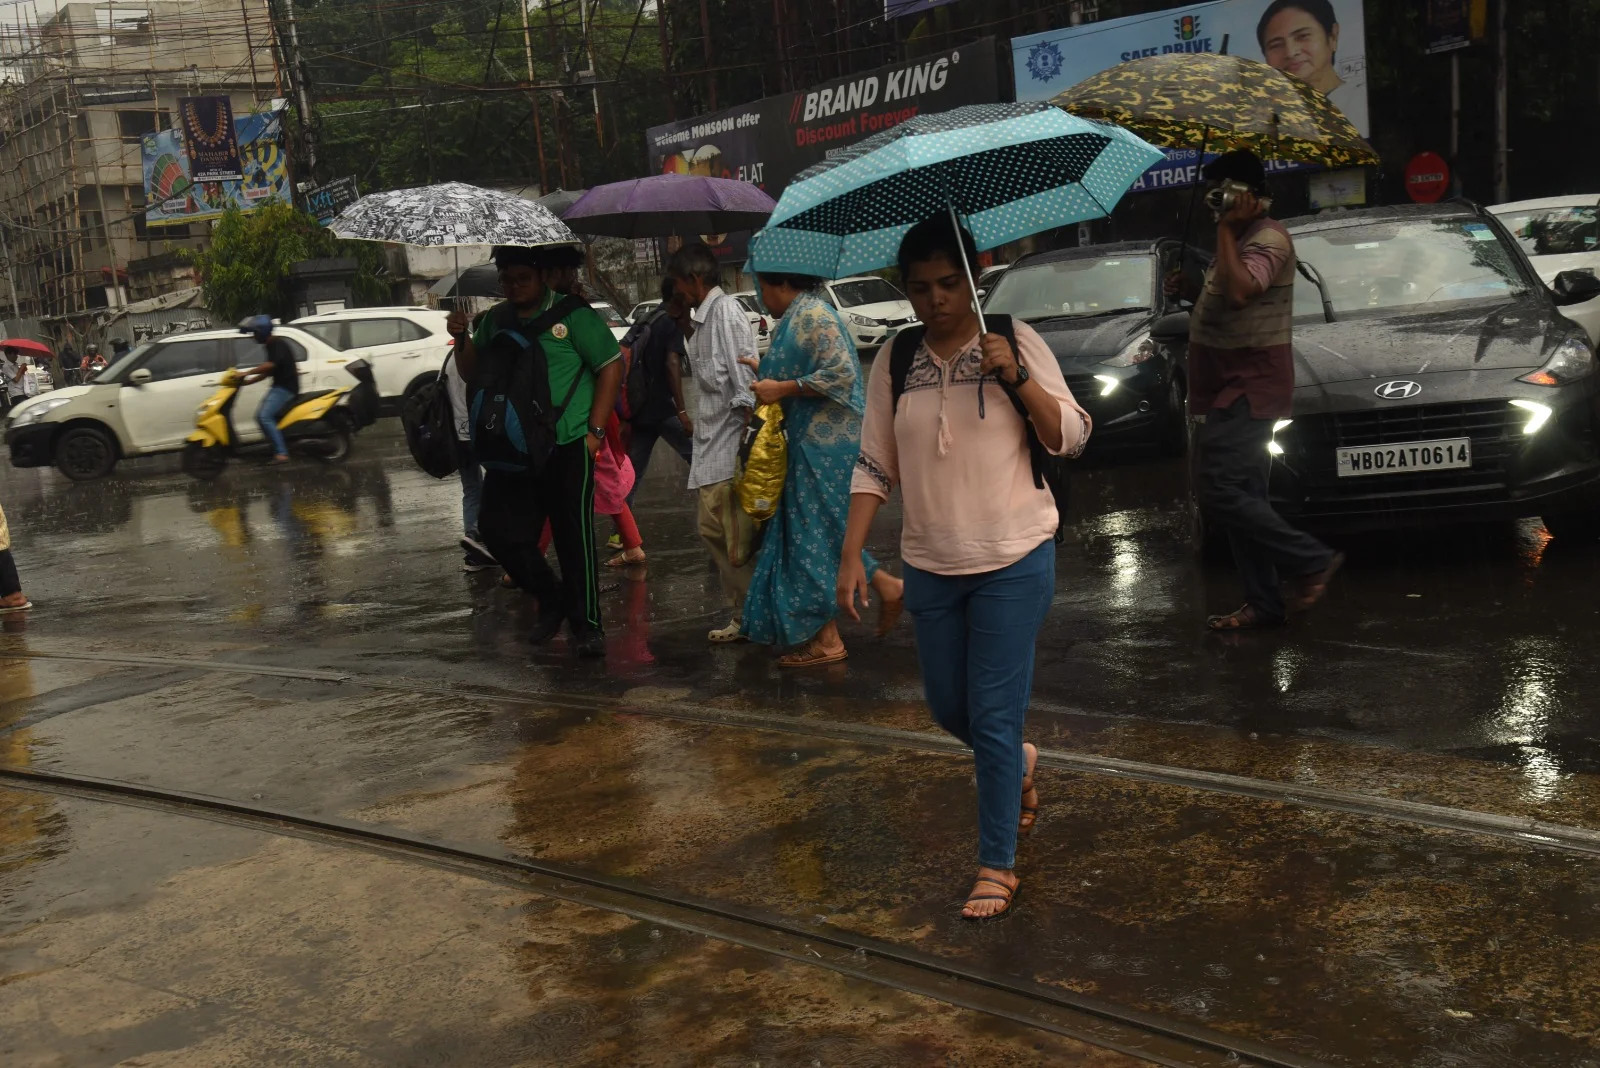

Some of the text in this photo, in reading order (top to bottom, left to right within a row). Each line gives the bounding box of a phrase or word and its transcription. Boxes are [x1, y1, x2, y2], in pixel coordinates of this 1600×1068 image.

[1121, 37, 1212, 62] SAFE DRIVE
[803, 57, 949, 122] BRAND KING
[654, 112, 761, 146] welcome MONSOON offer
[796, 105, 919, 147] Discount Forever
[738, 162, 764, 184] FLAT
[1350, 444, 1467, 471] WB02AT0614
